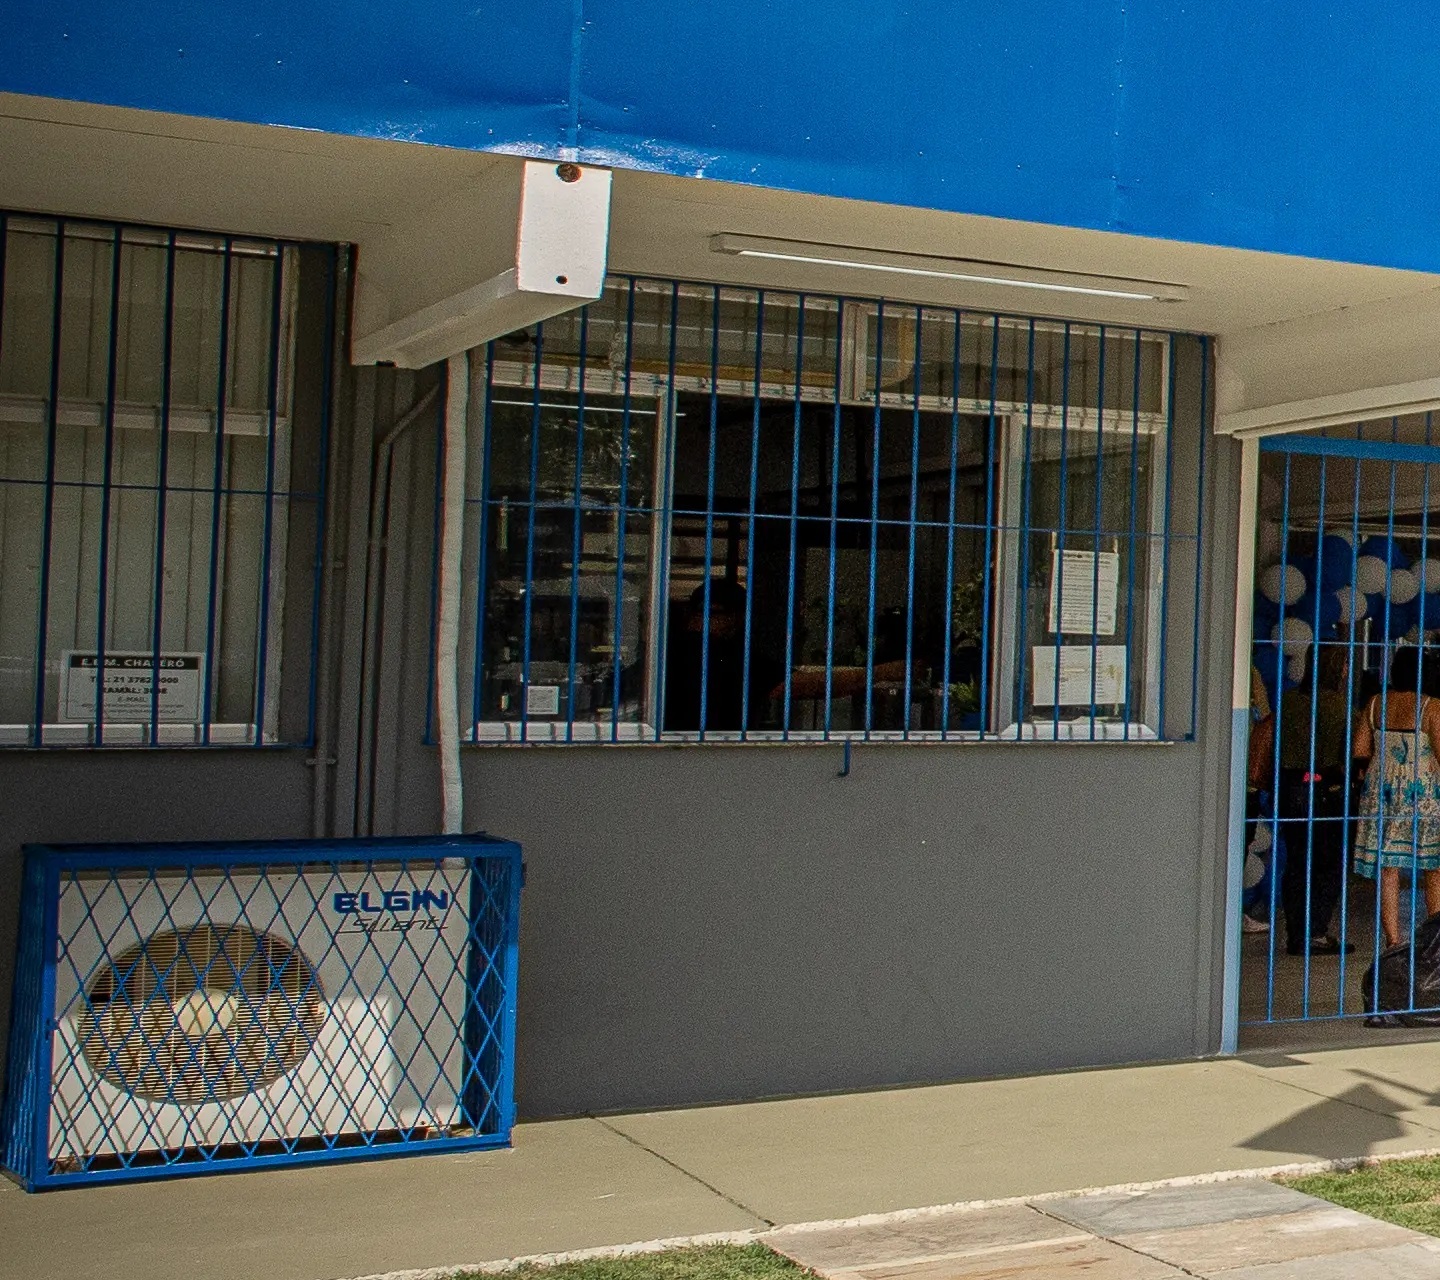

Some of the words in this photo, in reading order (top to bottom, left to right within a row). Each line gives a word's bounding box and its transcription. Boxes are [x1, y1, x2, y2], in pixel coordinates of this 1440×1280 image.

[123, 657, 186, 668] CHAERÓ
[90, 676, 110, 684] TL:
[334, 889, 449, 914] ELGIN
